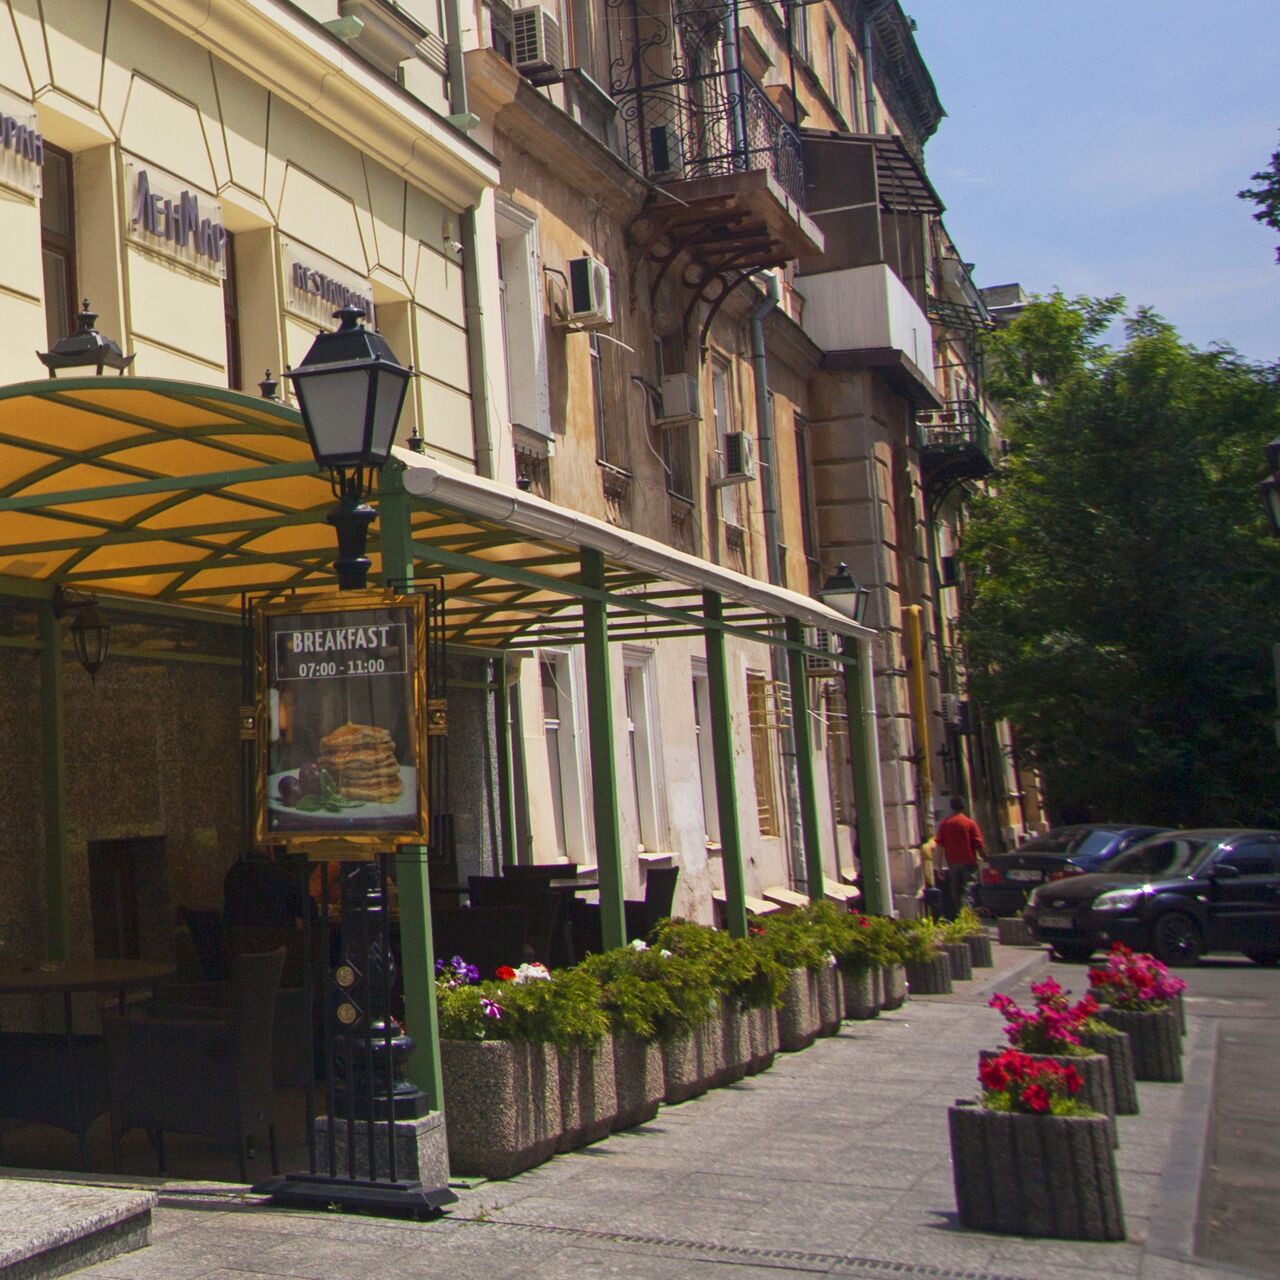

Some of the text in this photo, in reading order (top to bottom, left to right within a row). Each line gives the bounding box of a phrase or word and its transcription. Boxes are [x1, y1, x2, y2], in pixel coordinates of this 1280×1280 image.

[293, 626, 389, 653] BREAKFAST
[299, 662, 336, 678] 07:00
[347, 659, 385, 674] 11:00
